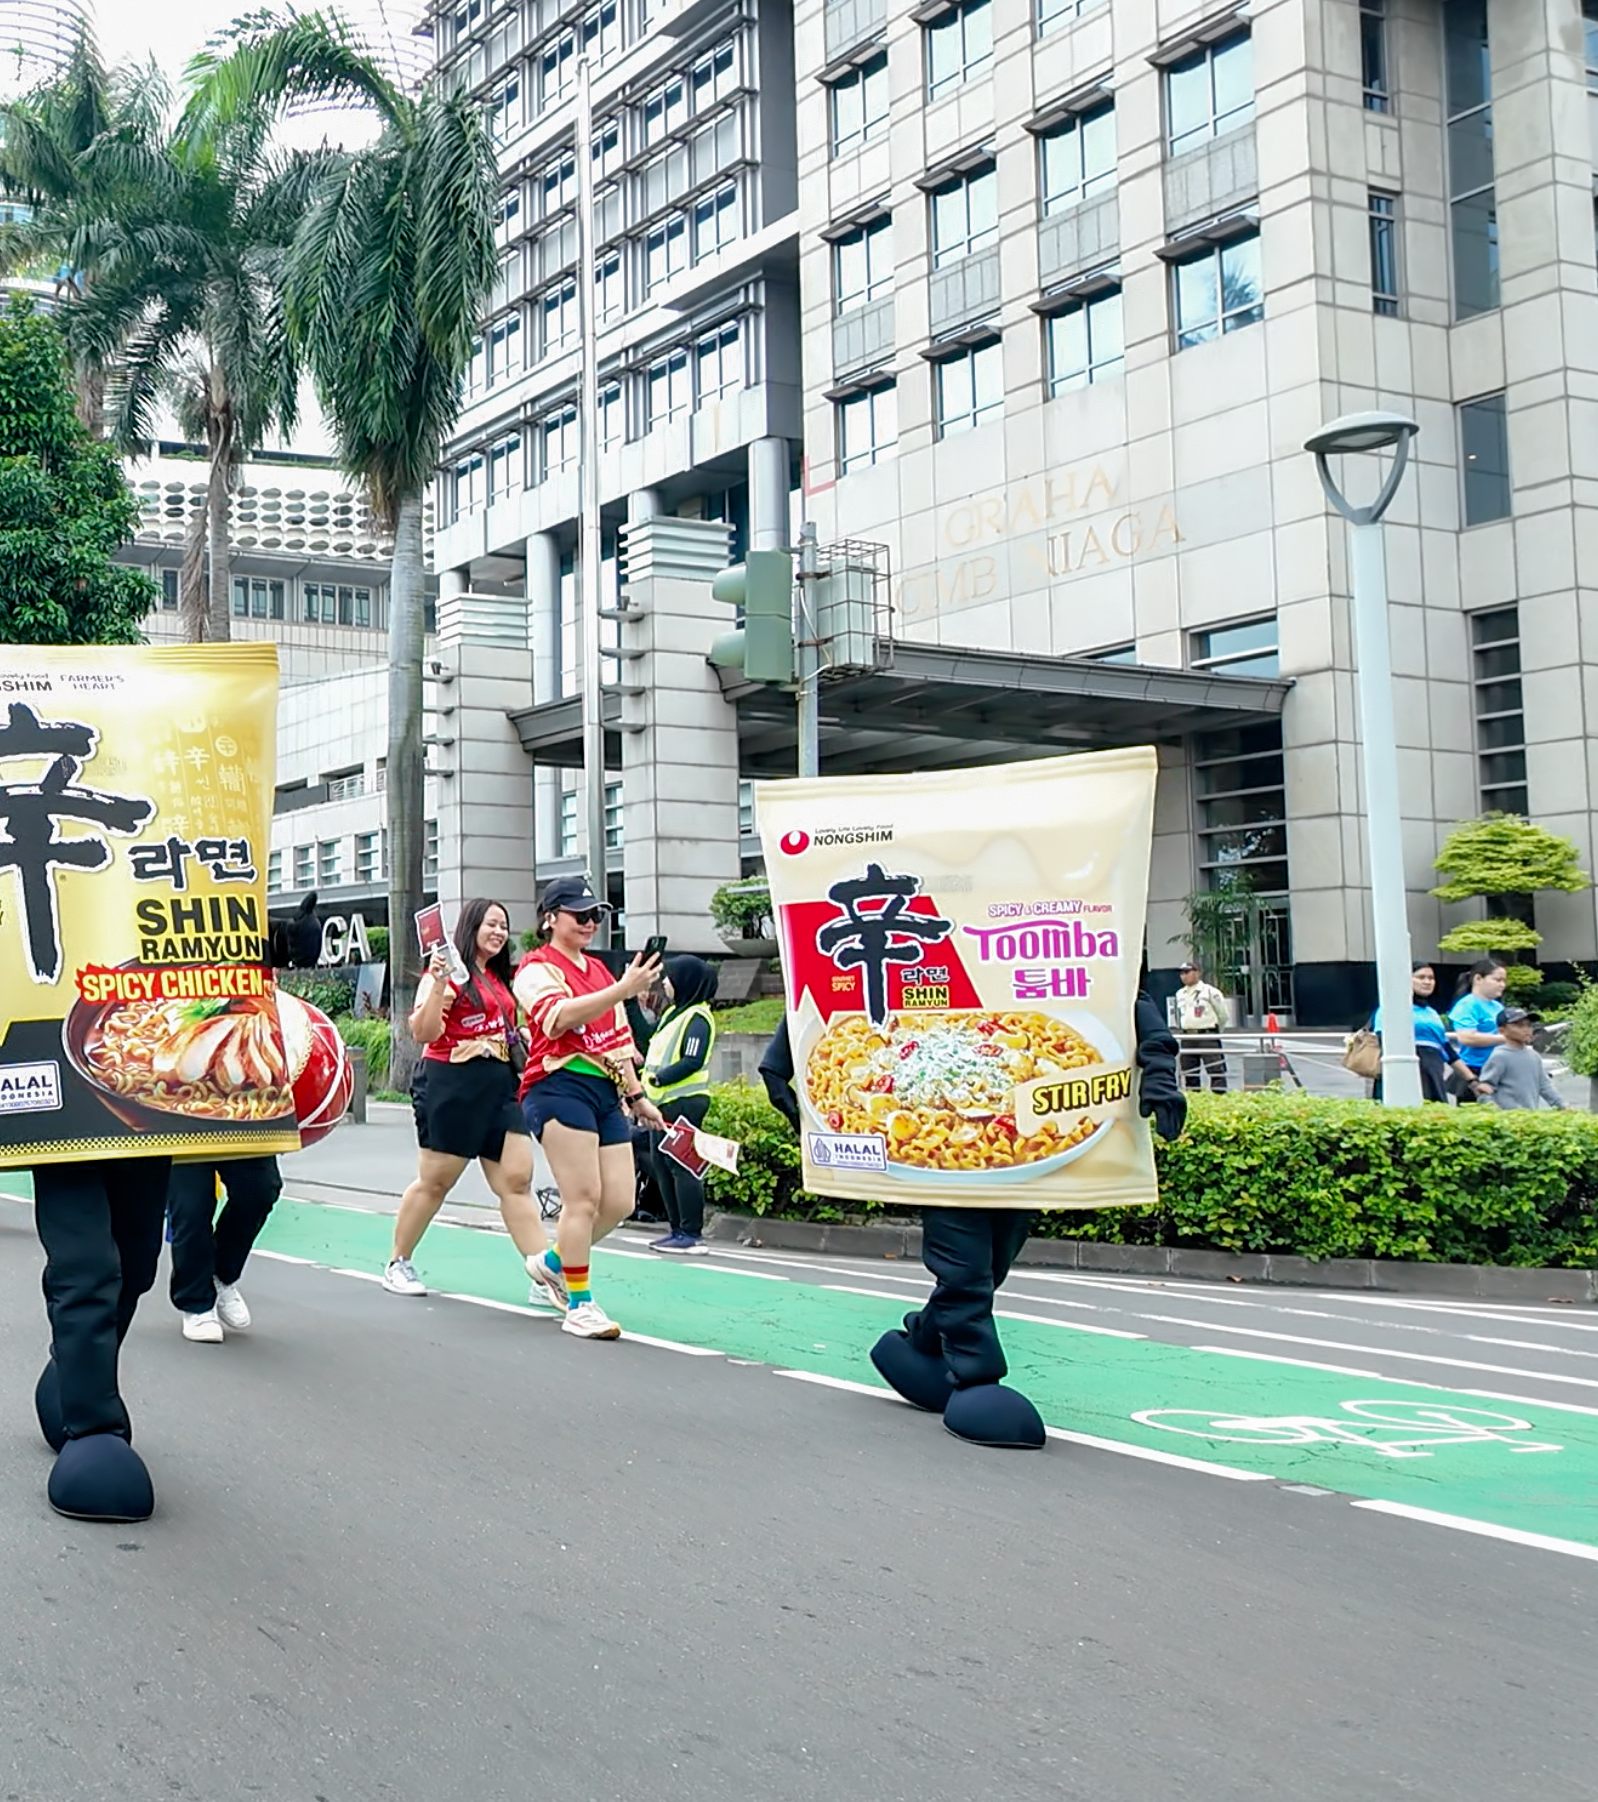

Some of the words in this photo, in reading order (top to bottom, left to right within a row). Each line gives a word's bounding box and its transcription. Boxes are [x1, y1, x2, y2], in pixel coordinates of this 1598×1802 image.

[945, 463, 1117, 547] GRAHA
[896, 555, 998, 616] CIMB
[1025, 504, 1186, 586] NIAGA
[814, 830, 893, 846] NONGSHIM
[128, 837, 255, 889] 라면
[136, 896, 259, 936] SHIN
[988, 903, 1023, 917] SPICY
[1033, 900, 1082, 915] CREAMY
[140, 935, 260, 960] RAMYUN
[318, 913, 372, 964] GA
[816, 862, 953, 1027] 辛
[962, 920, 1118, 961] Toomba
[82, 972, 155, 1002] SPICY
[161, 969, 263, 1000] CHICKEN
[832, 982, 855, 991] SPICY
[902, 965, 950, 984] 라면
[1012, 967, 1092, 999] 툼바
[904, 987, 948, 999] SHIN
[1033, 1080, 1090, 1115] STIR
[1091, 1068, 1131, 1105] FRY
[834, 1143, 880, 1155] HALAL
